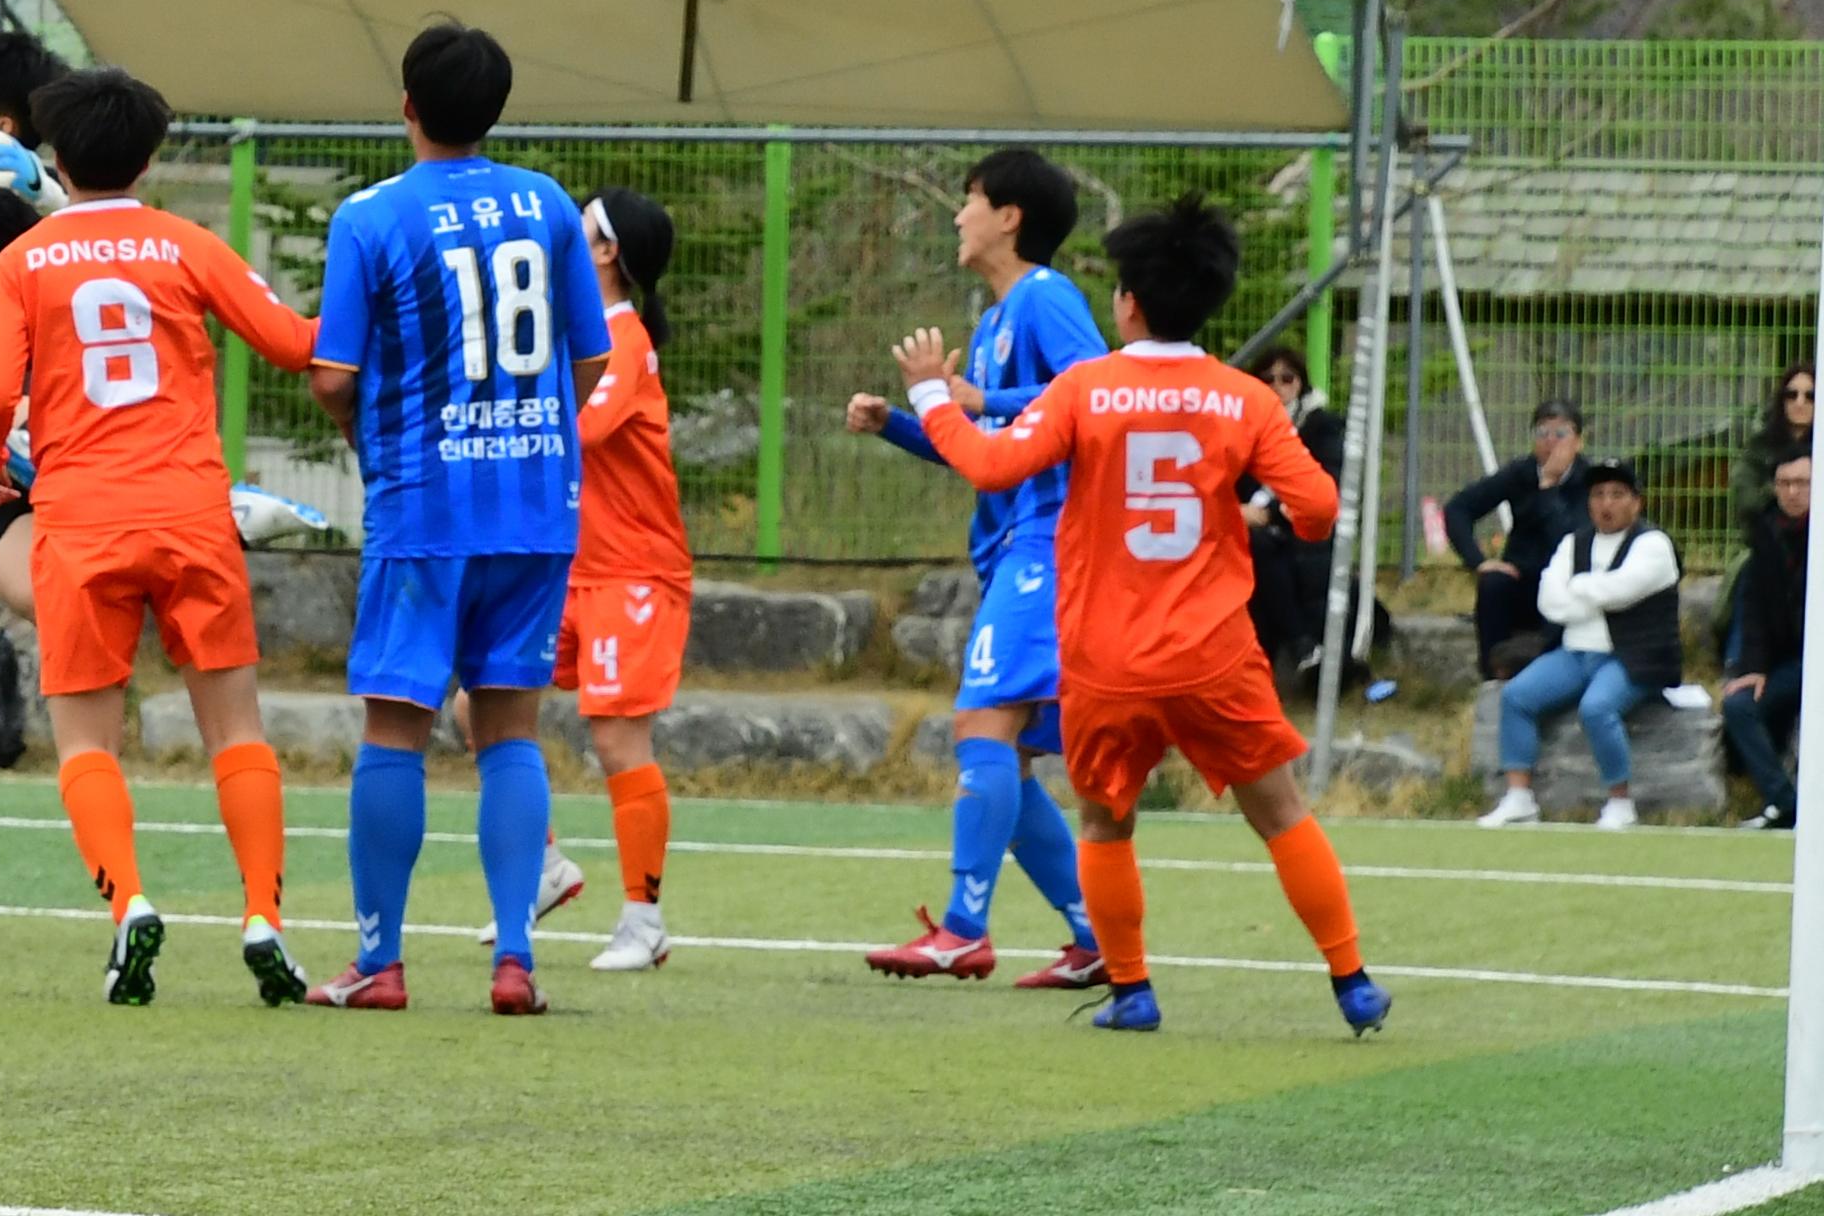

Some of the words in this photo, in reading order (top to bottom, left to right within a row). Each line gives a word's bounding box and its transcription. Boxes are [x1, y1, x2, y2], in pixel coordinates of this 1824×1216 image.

[429, 190, 542, 234] 고유나
[26, 238, 180, 272] DONGSAN
[442, 239, 553, 381] 18
[71, 278, 159, 410] 8
[1090, 387, 1244, 421] DONGSAN
[1124, 431, 1203, 561] 5
[592, 635, 618, 680] 4
[969, 623, 995, 675] 4
